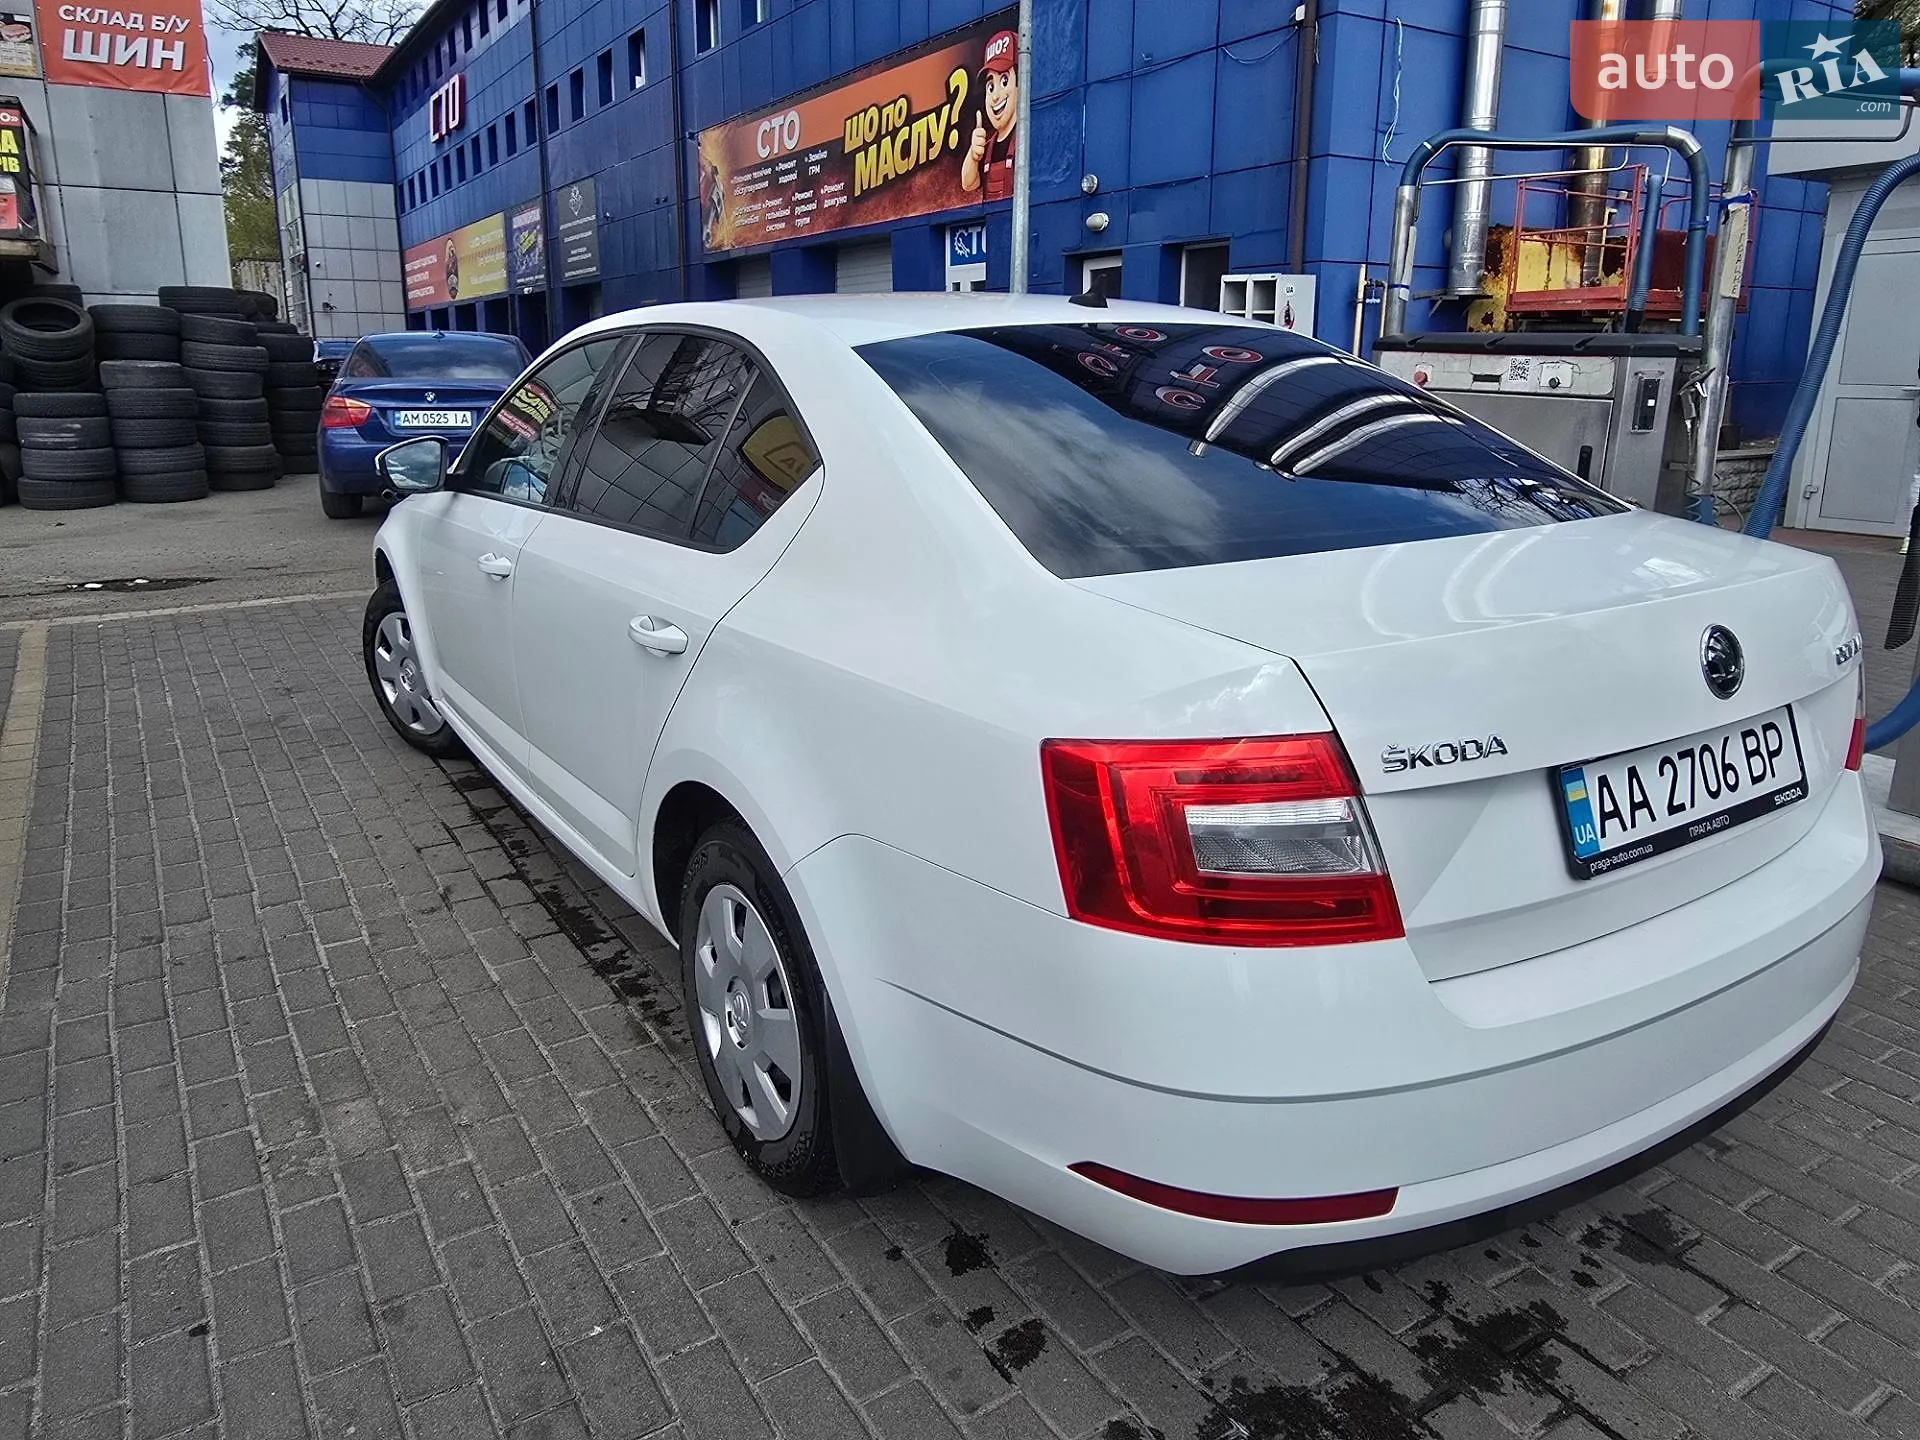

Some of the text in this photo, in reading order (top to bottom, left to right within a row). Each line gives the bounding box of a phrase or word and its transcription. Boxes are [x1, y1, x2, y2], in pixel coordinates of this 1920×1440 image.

[58, 5, 191, 34] СКЛАД Б/У
[63, 29, 186, 71] ШИН
[986, 36, 1010, 58] ШО?
[429, 73, 461, 143] СТО
[844, 97, 908, 154] ШО ПО
[756, 110, 801, 160] СТО
[402, 412, 422, 424] AM
[422, 412, 449, 424] 0525
[1381, 734, 1509, 774] ŠKODA
[1597, 720, 1784, 839] AA 2706 BP
[1574, 823, 1597, 845] UA
[1688, 815, 1730, 838] ПРАГА АВТО
[1589, 843, 1654, 874] praga-auto.com.ua
